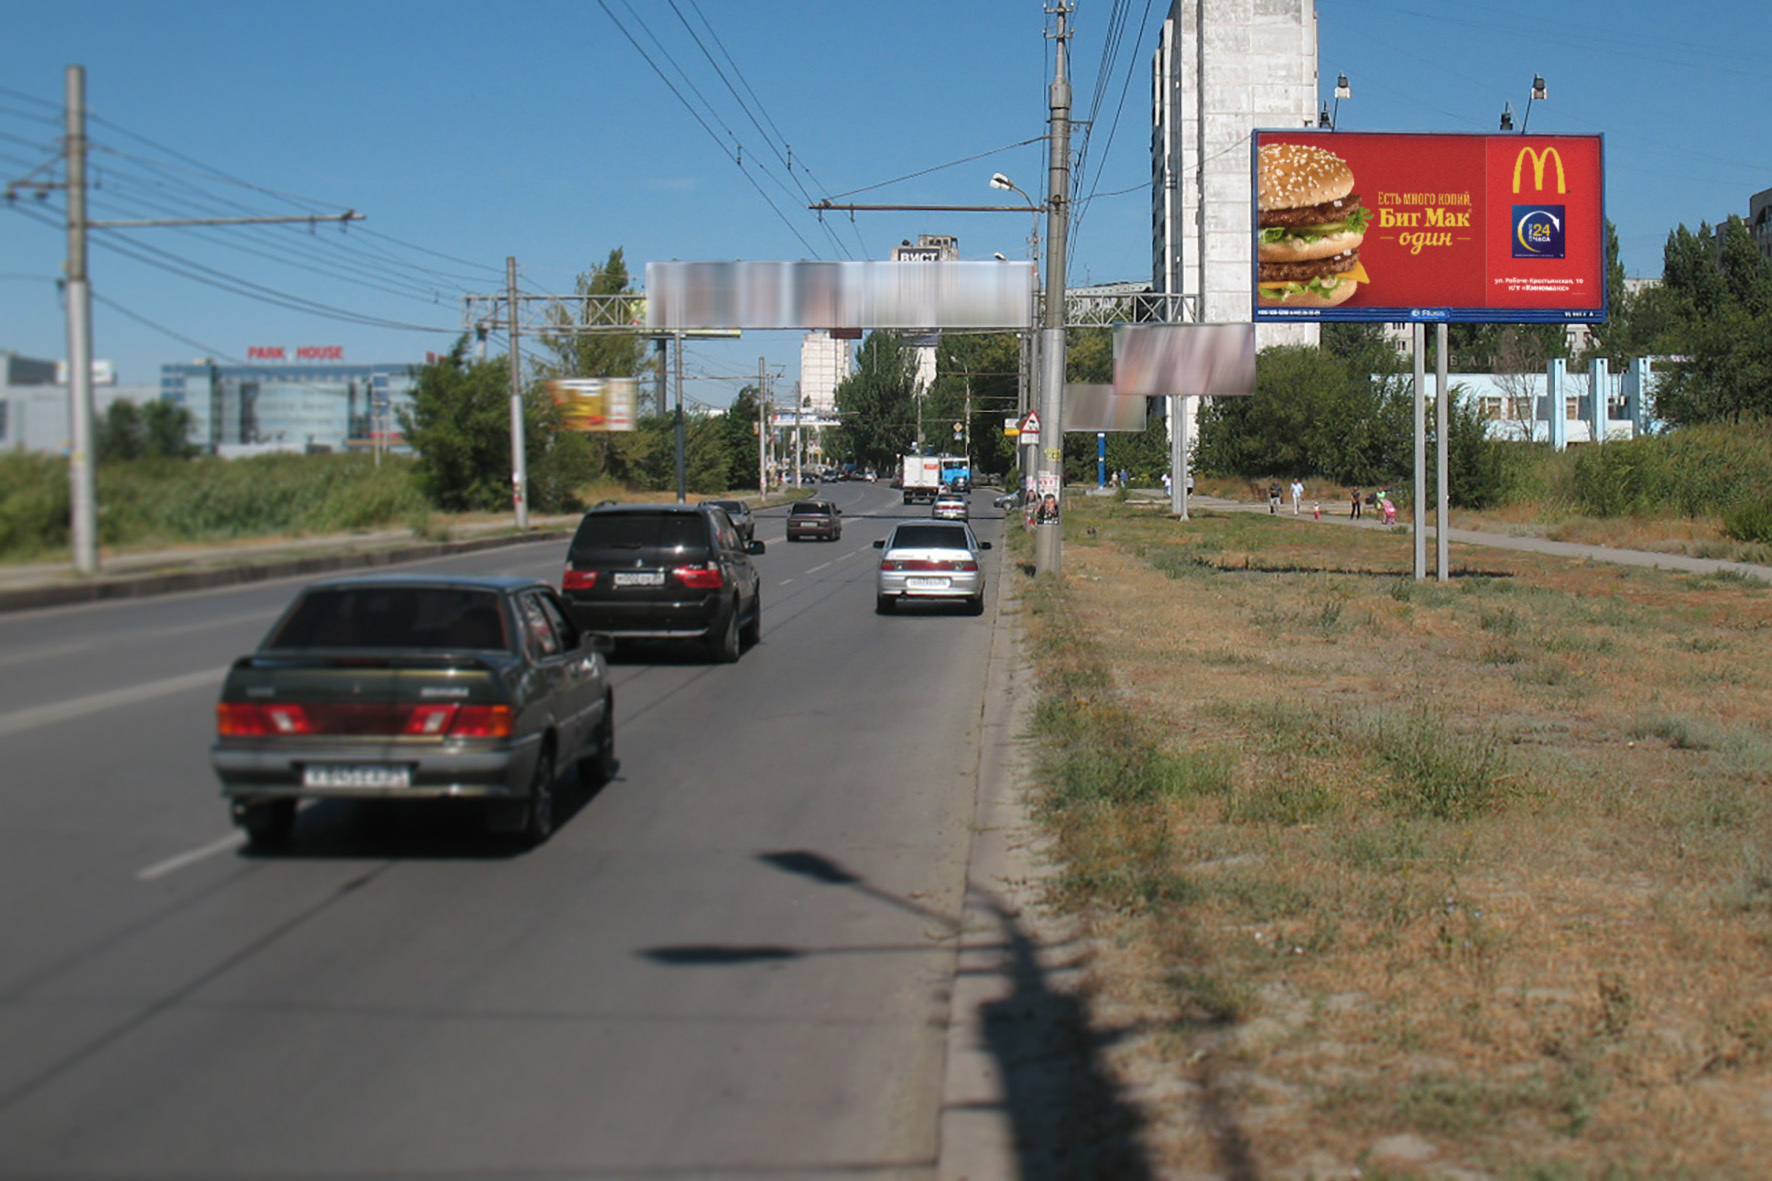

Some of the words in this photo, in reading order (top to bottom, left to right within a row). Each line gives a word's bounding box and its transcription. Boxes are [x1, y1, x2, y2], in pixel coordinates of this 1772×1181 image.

[1378, 207, 1421, 228] Биг
[1532, 223, 1551, 237] 24
[1399, 231, 1453, 255] один
[900, 252, 938, 262] ВИСТ
[248, 346, 285, 360] PARK
[296, 346, 344, 361] HOUSE
